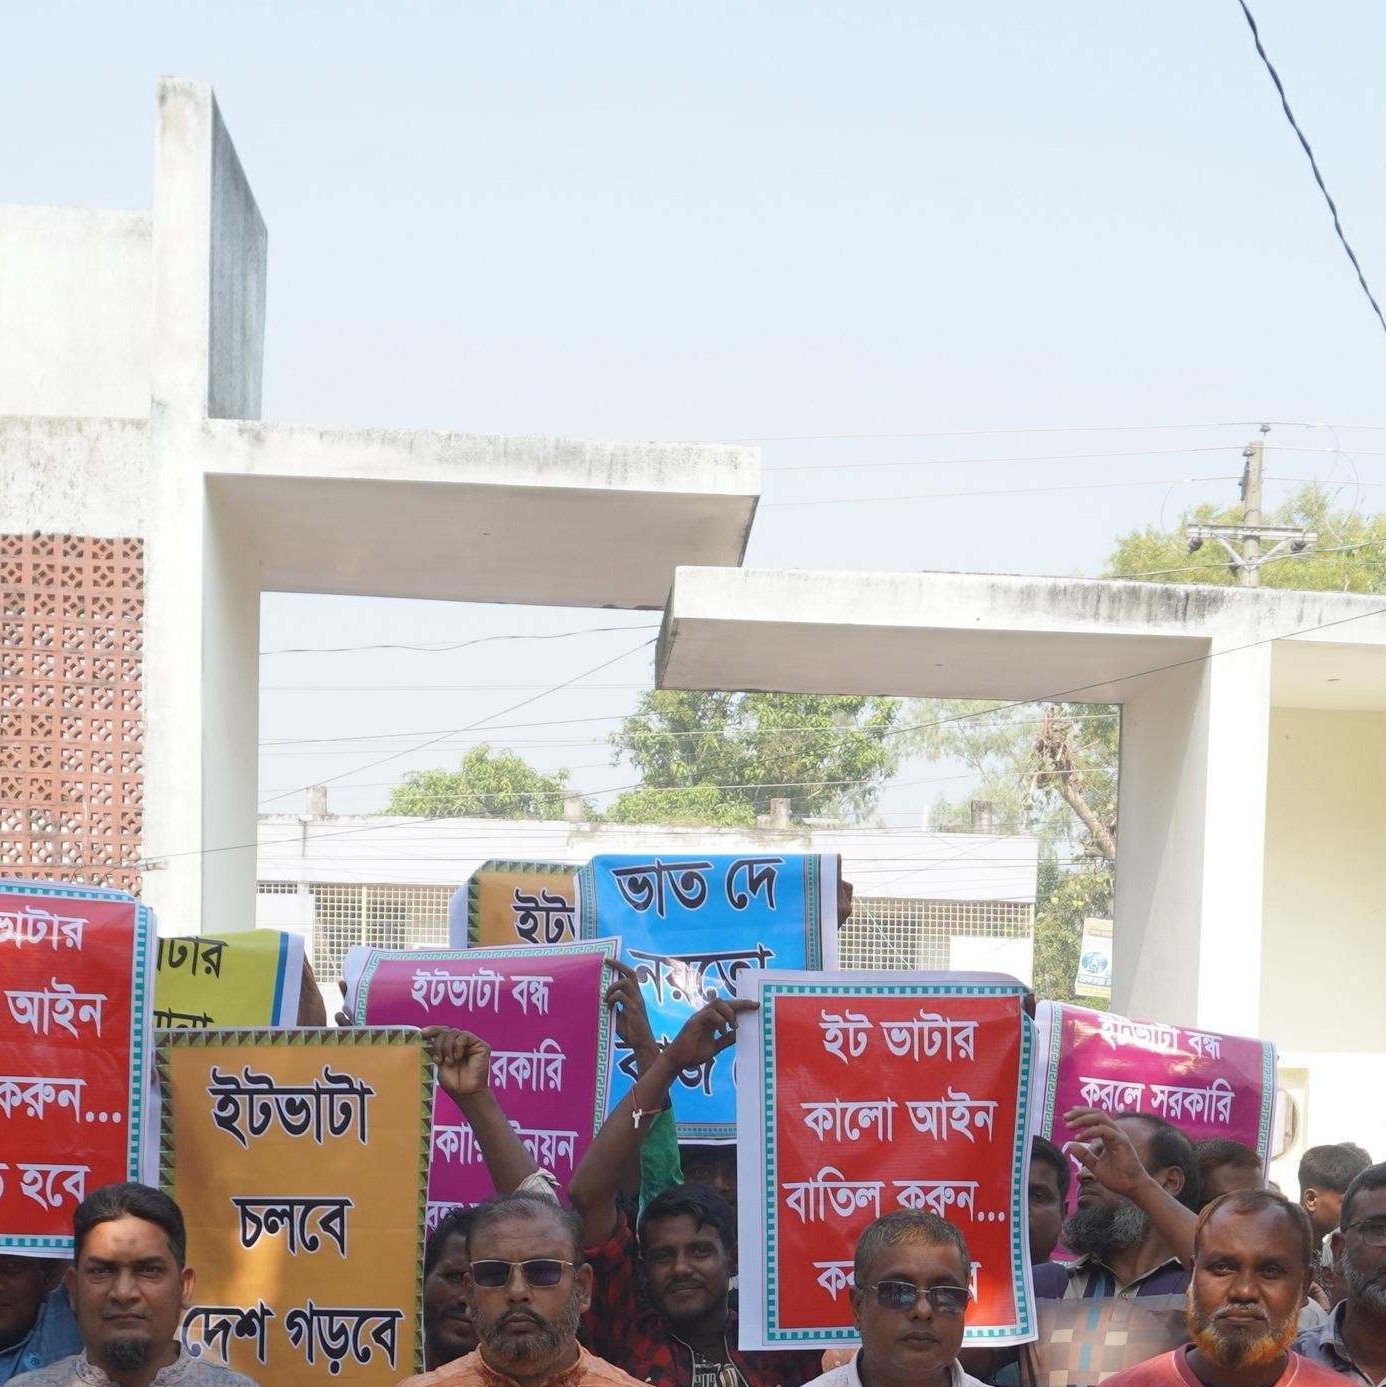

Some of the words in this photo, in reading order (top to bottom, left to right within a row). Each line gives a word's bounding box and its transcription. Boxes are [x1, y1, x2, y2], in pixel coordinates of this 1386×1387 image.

[610, 859, 713, 920] ভাত
[726, 857, 785, 910] দে
[4, 978, 108, 1039] আইন
[411, 968, 506, 1015] ইটভাটা
[510, 974, 555, 1016] বন্ধ
[818, 1009, 875, 1062] ইট
[880, 1017, 980, 1062] ভাটার
[1185, 1031, 1223, 1060] বন্ধ
[488, 1038, 567, 1091] রকারি
[207, 1066, 375, 1149] ইটভাটা
[801, 1098, 897, 1145] কালো
[904, 1086, 999, 1144] আইন
[1078, 1077, 1146, 1112] করলে
[1150, 1077, 1236, 1124] সরকারি
[18, 1162, 91, 1209] হবে
[782, 1166, 885, 1223] বাতিল
[892, 1180, 1005, 1223] করুন...
[229, 1196, 354, 1259] চলবে
[181, 1304, 275, 1365] দেশ
[284, 1299, 406, 1378] গড়বে
